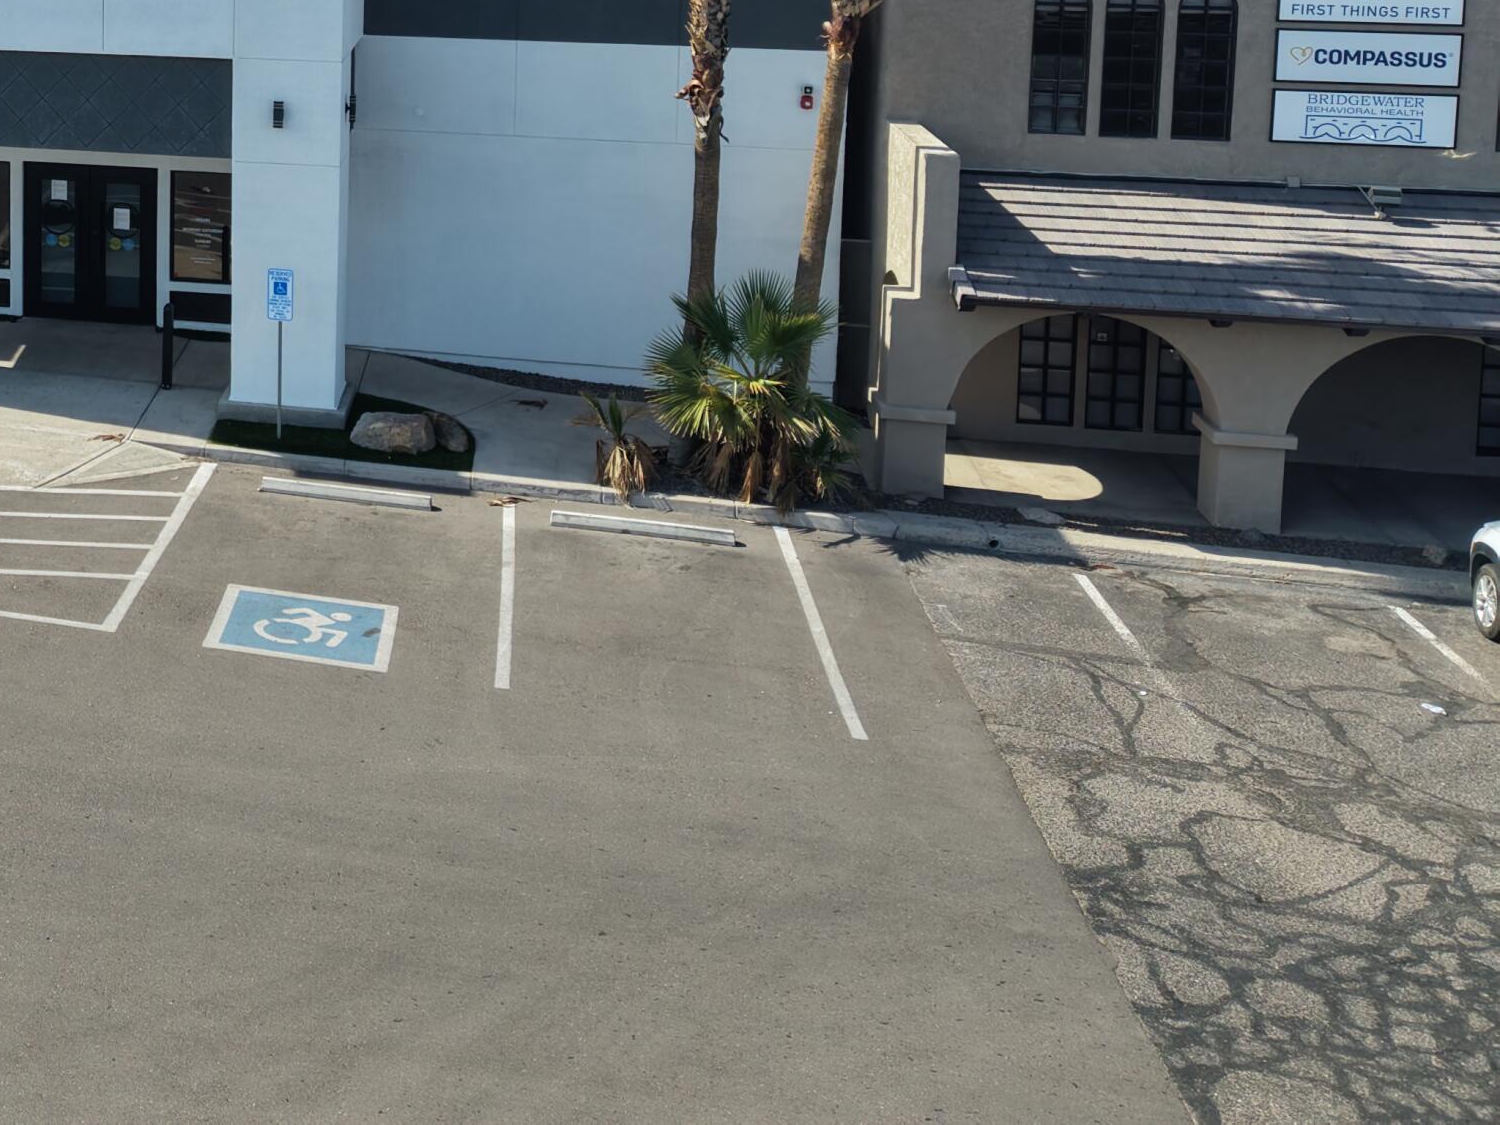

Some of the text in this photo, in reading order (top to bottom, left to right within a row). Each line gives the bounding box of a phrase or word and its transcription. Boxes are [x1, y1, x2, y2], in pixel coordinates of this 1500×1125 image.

[1291, 3, 1451, 19] FIRST THINGS FIRST
[1314, 48, 1448, 68] COMPASSUS
[1307, 93, 1425, 108] BRIDGEWATER
[1306, 106, 1424, 117] BEHAVIORAL HEALTH
